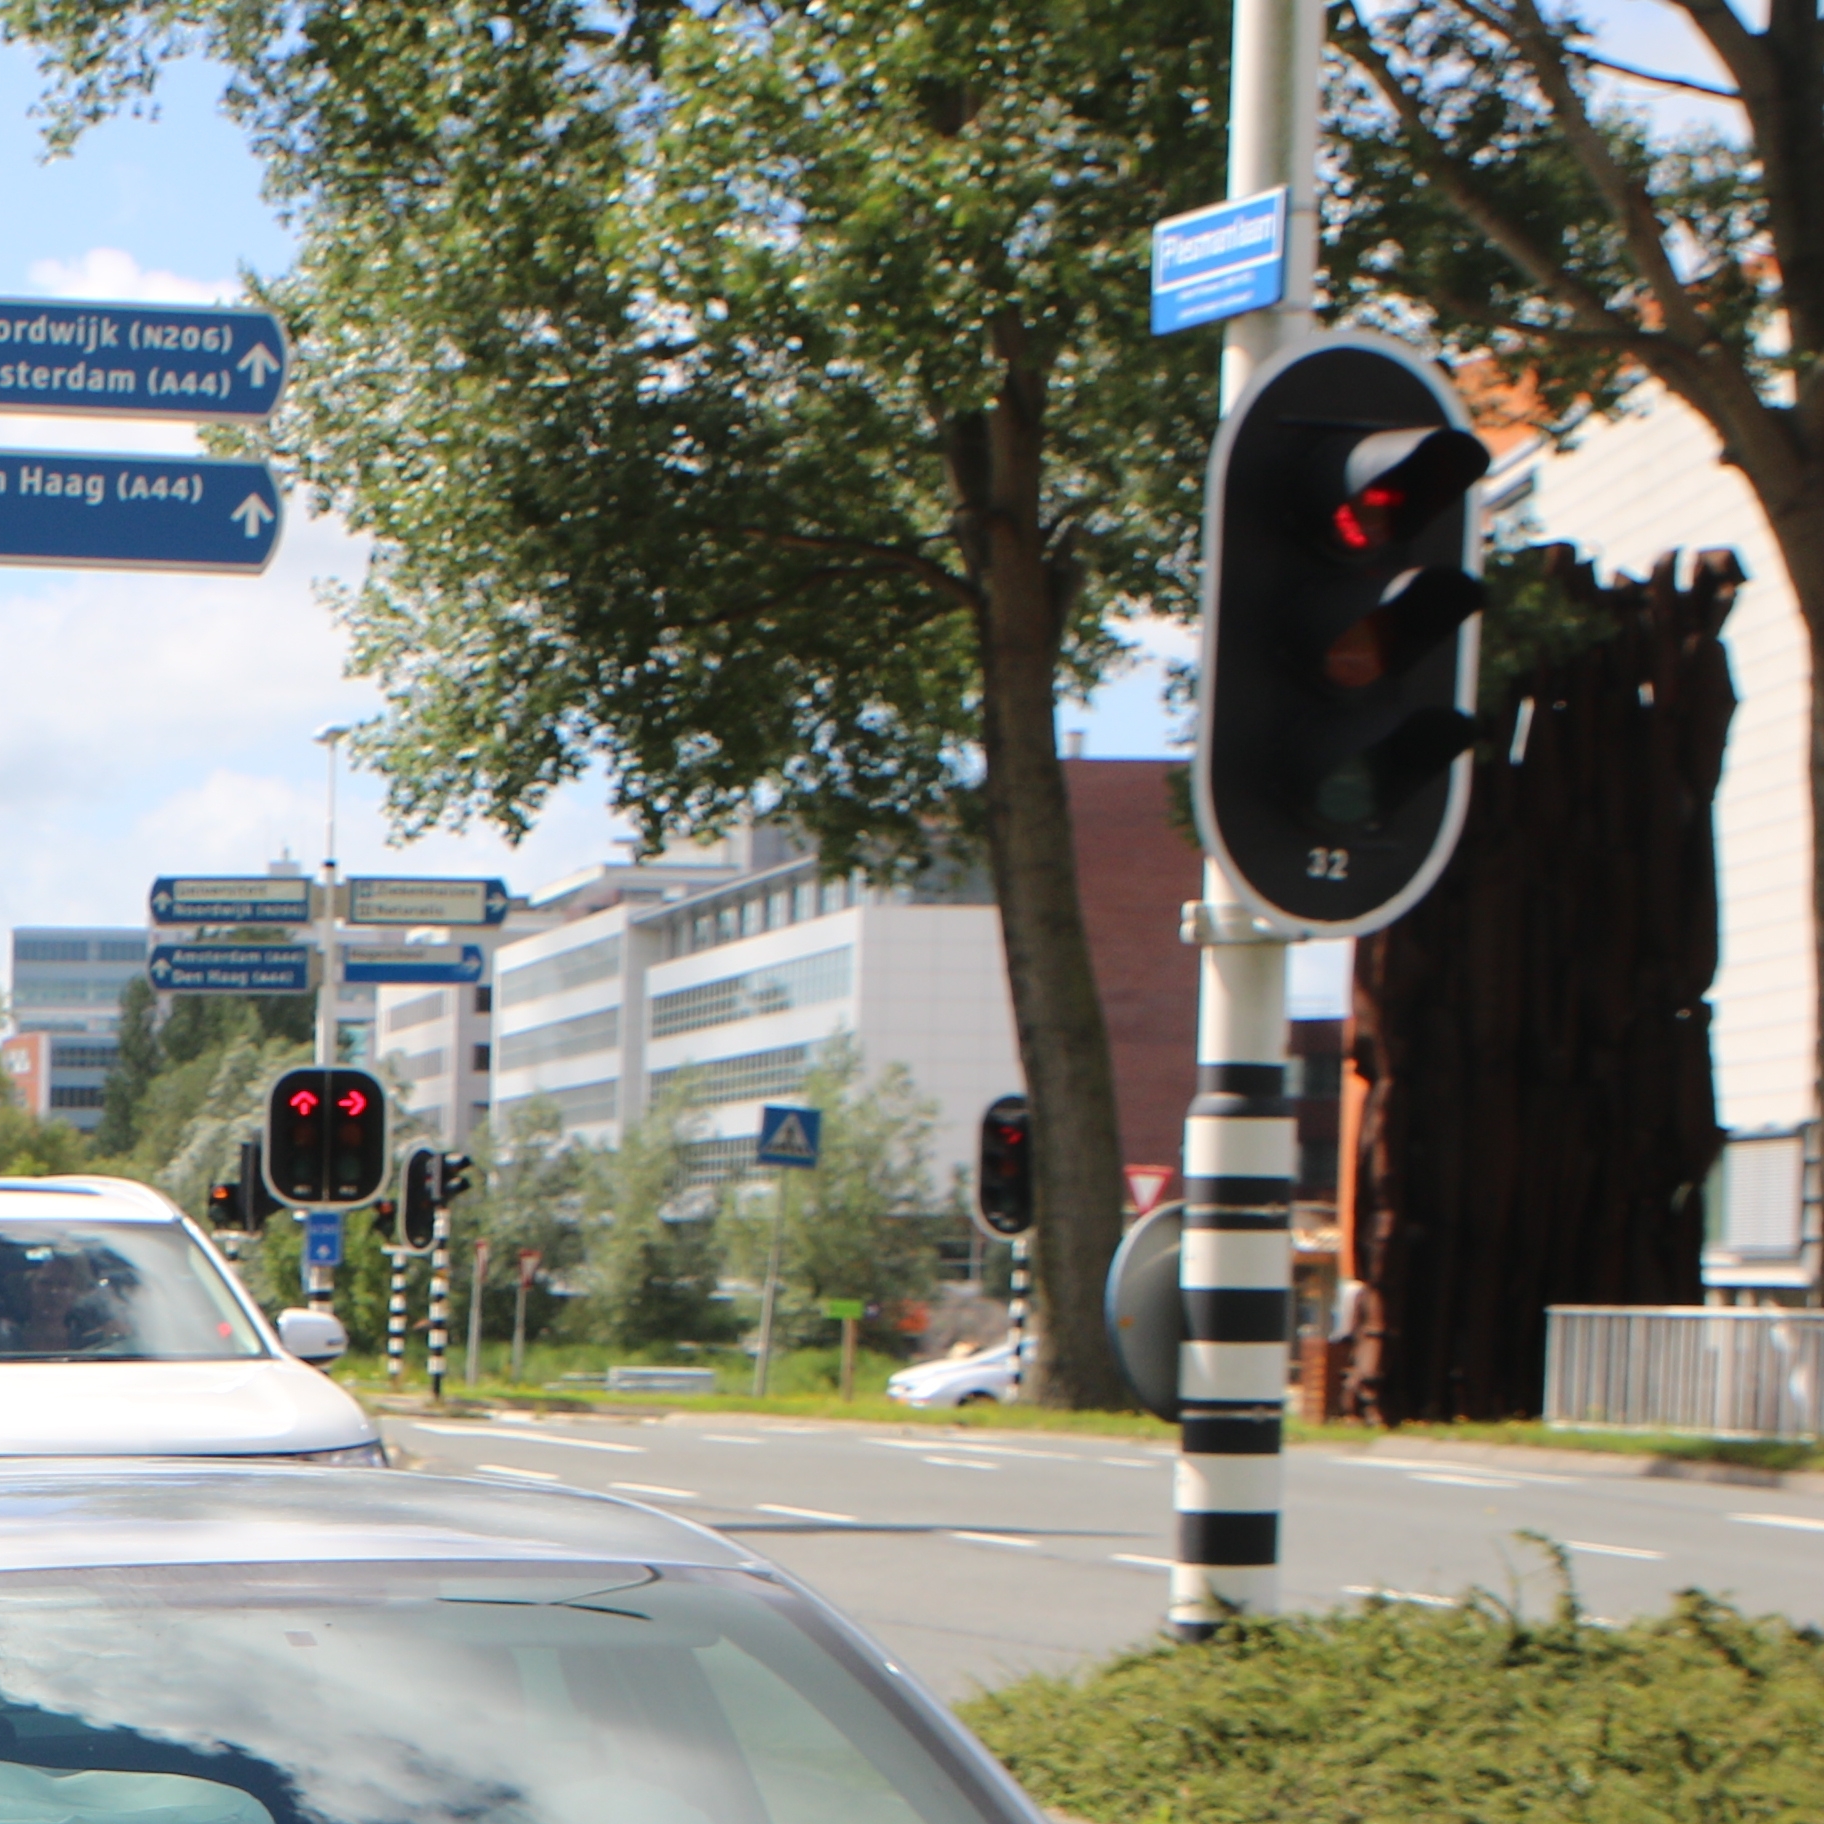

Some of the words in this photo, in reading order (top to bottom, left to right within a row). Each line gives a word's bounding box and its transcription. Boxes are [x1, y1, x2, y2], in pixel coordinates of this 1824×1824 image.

[129, 320, 232, 355] (N206)
[147, 367, 231, 399] (A44)
[19, 466, 104, 505] Haag
[117, 472, 202, 504] (A44)
[1306, 847, 1349, 880] 32
[172, 950, 263, 964] Amsterdam
